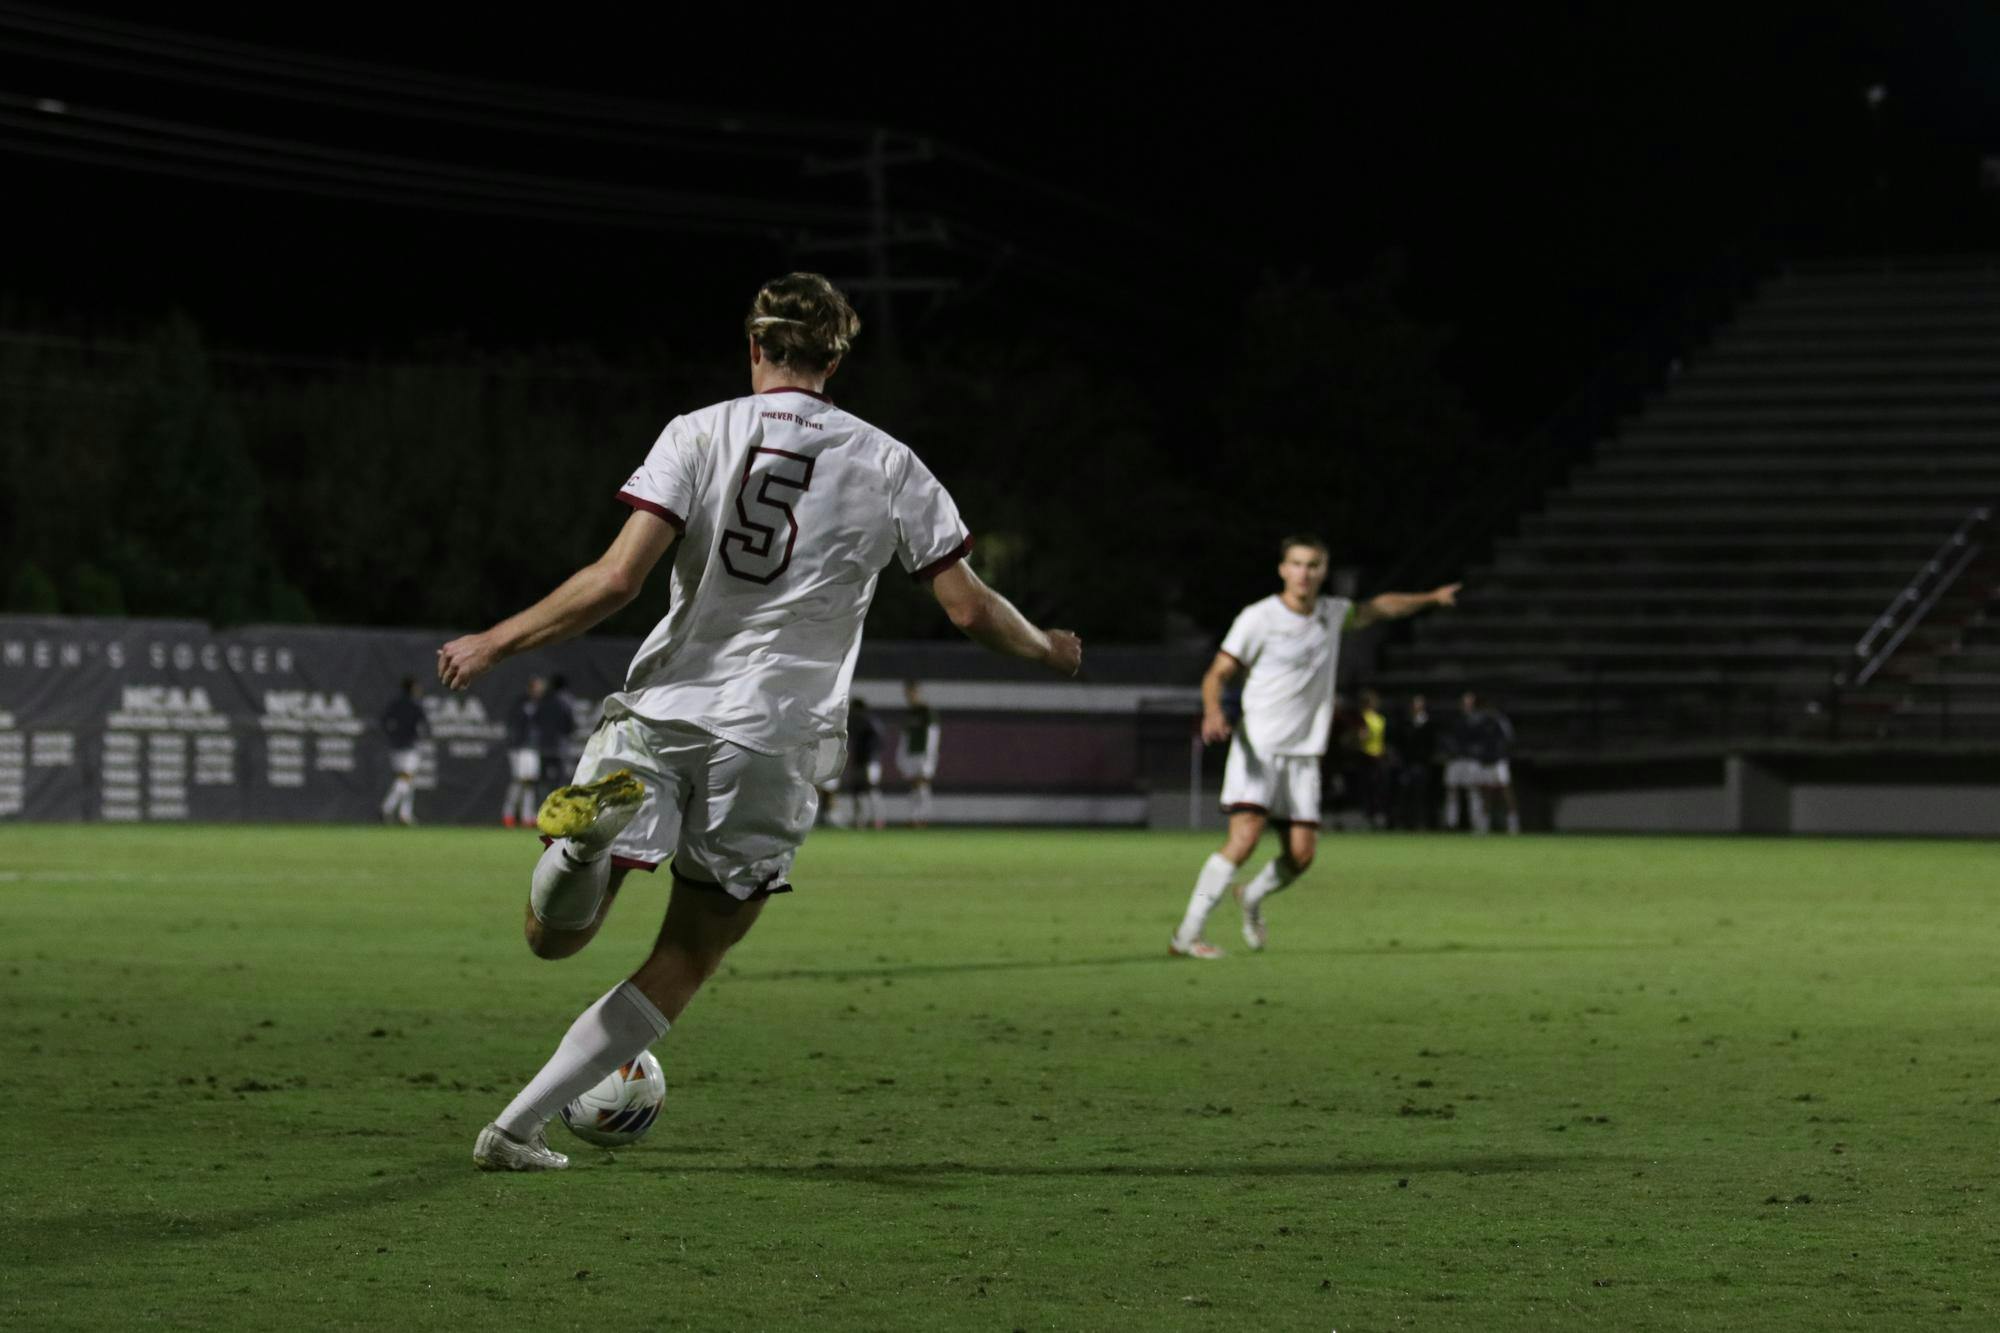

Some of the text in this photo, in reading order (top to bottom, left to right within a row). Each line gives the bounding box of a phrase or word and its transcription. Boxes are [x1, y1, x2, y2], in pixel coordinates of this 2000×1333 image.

[761, 411, 793, 422] OREVER
[795, 414, 803, 426] TO
[719, 446, 815, 584] 5
[149, 641, 294, 674] SOCCER
